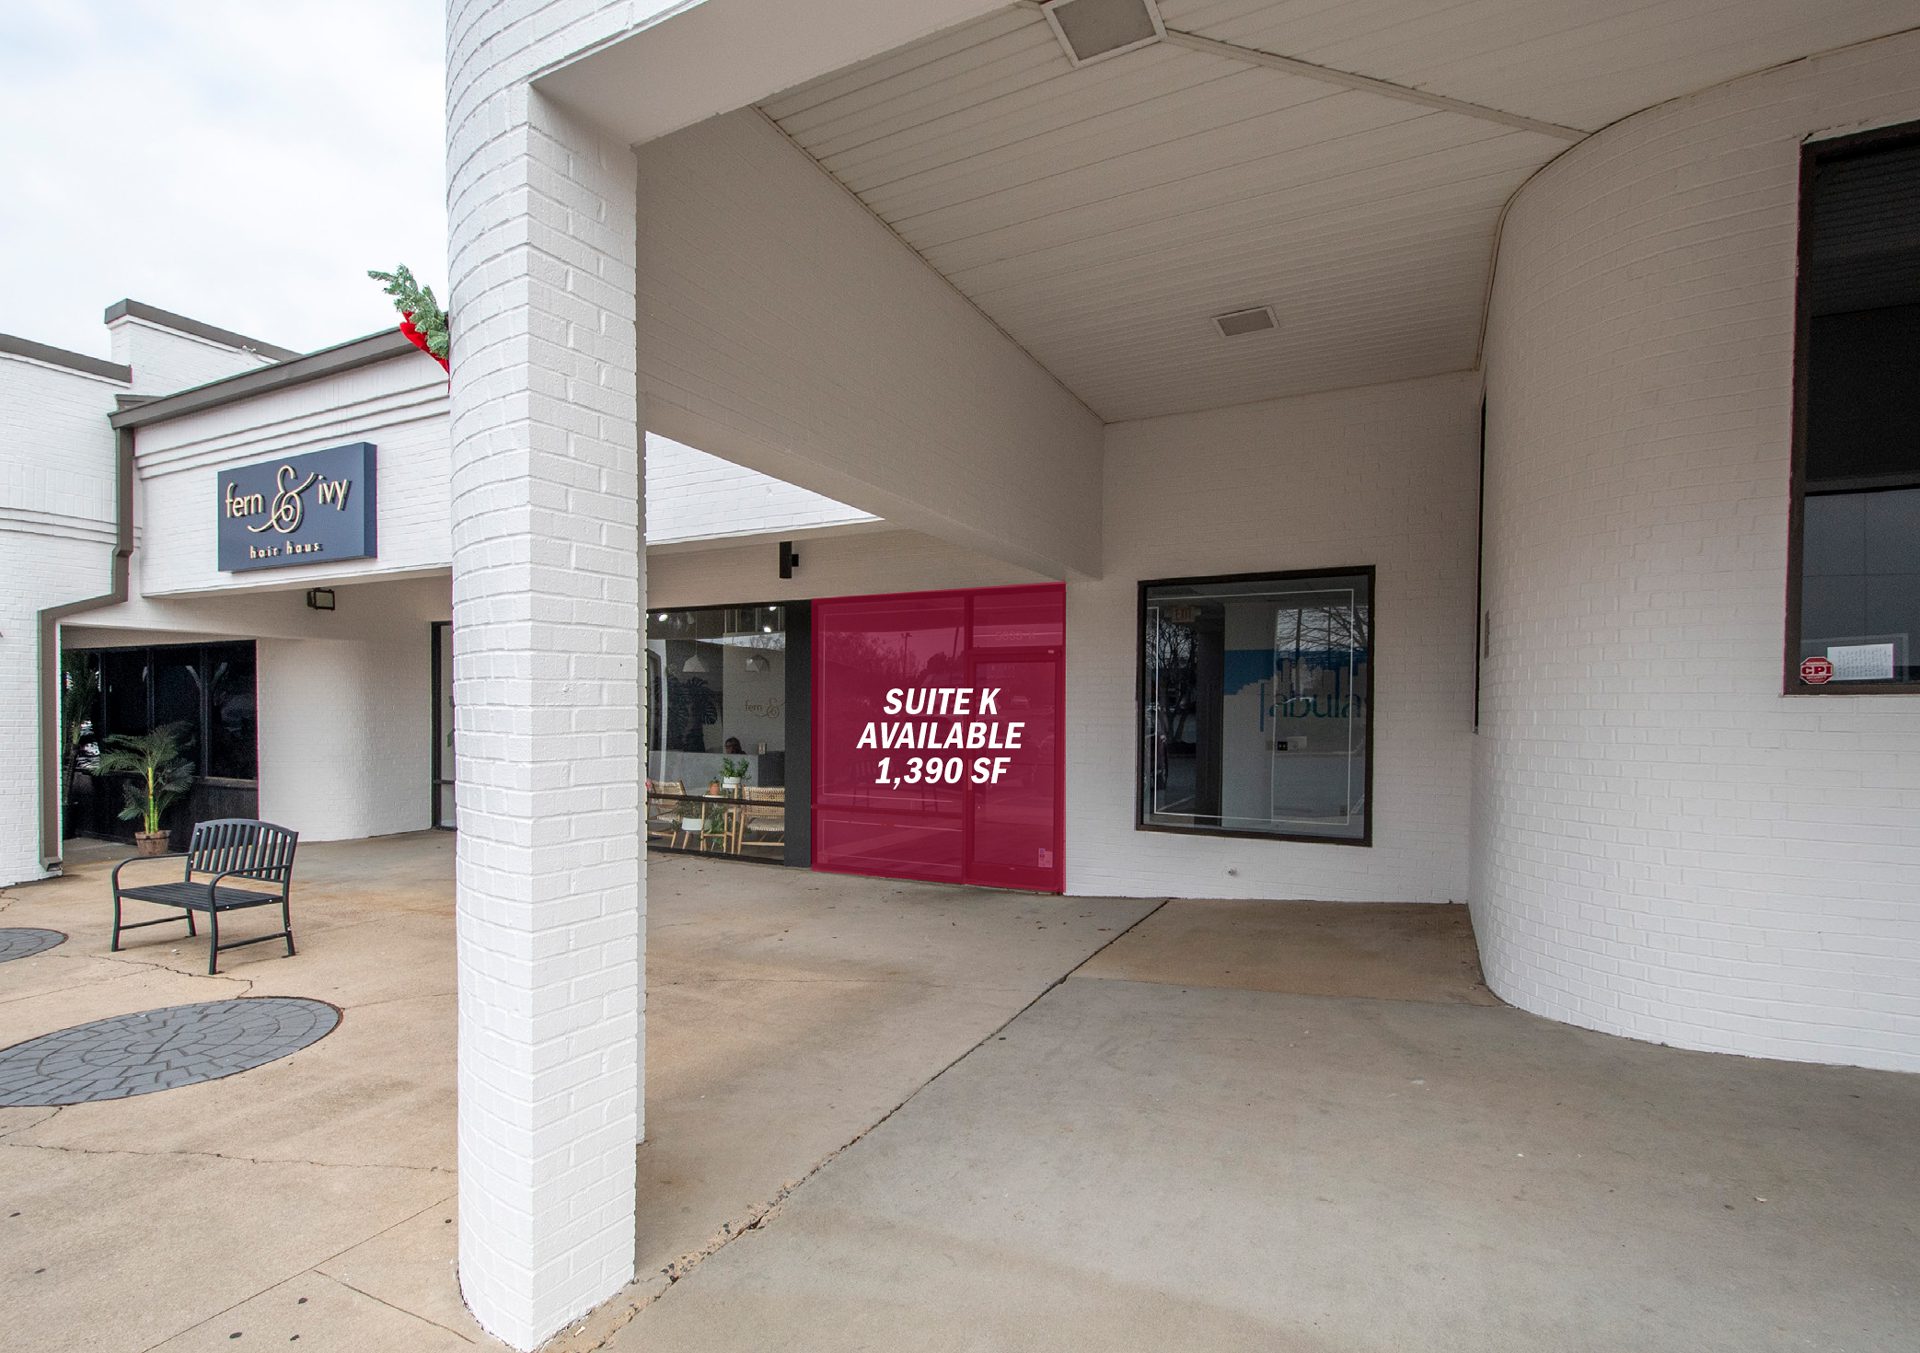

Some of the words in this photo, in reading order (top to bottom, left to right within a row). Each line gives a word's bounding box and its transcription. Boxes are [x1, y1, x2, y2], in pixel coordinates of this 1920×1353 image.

[225, 482, 264, 518] fern
[247, 465, 315, 533] &
[317, 475, 349, 511] ivy
[250, 545, 278, 559] hair
[286, 540, 319, 555] haus
[1801, 666, 1832, 675] CPI
